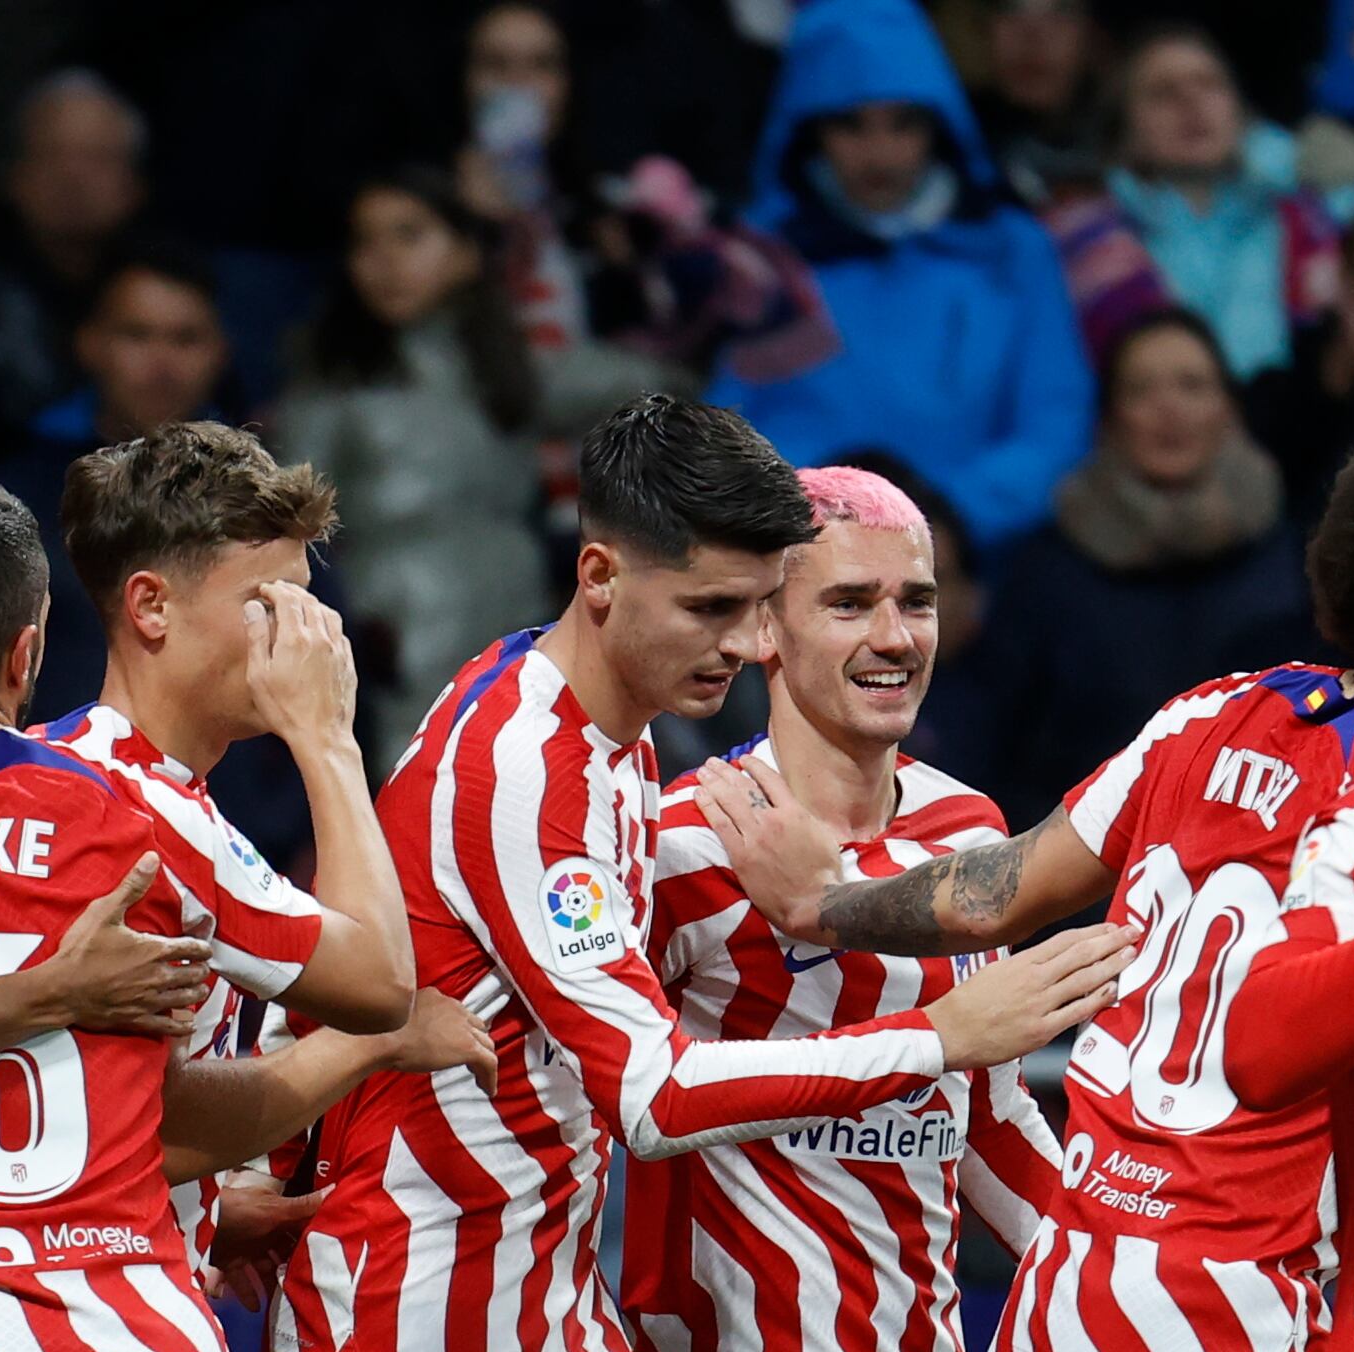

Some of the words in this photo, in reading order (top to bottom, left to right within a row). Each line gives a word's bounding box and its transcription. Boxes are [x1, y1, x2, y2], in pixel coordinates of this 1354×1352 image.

[559, 931, 616, 957] LaLiga
[1065, 843, 1283, 1135] 20
[1101, 1150, 1173, 1193] Money
[1083, 1170, 1177, 1219] Transfer
[43, 1222, 132, 1251] Money
